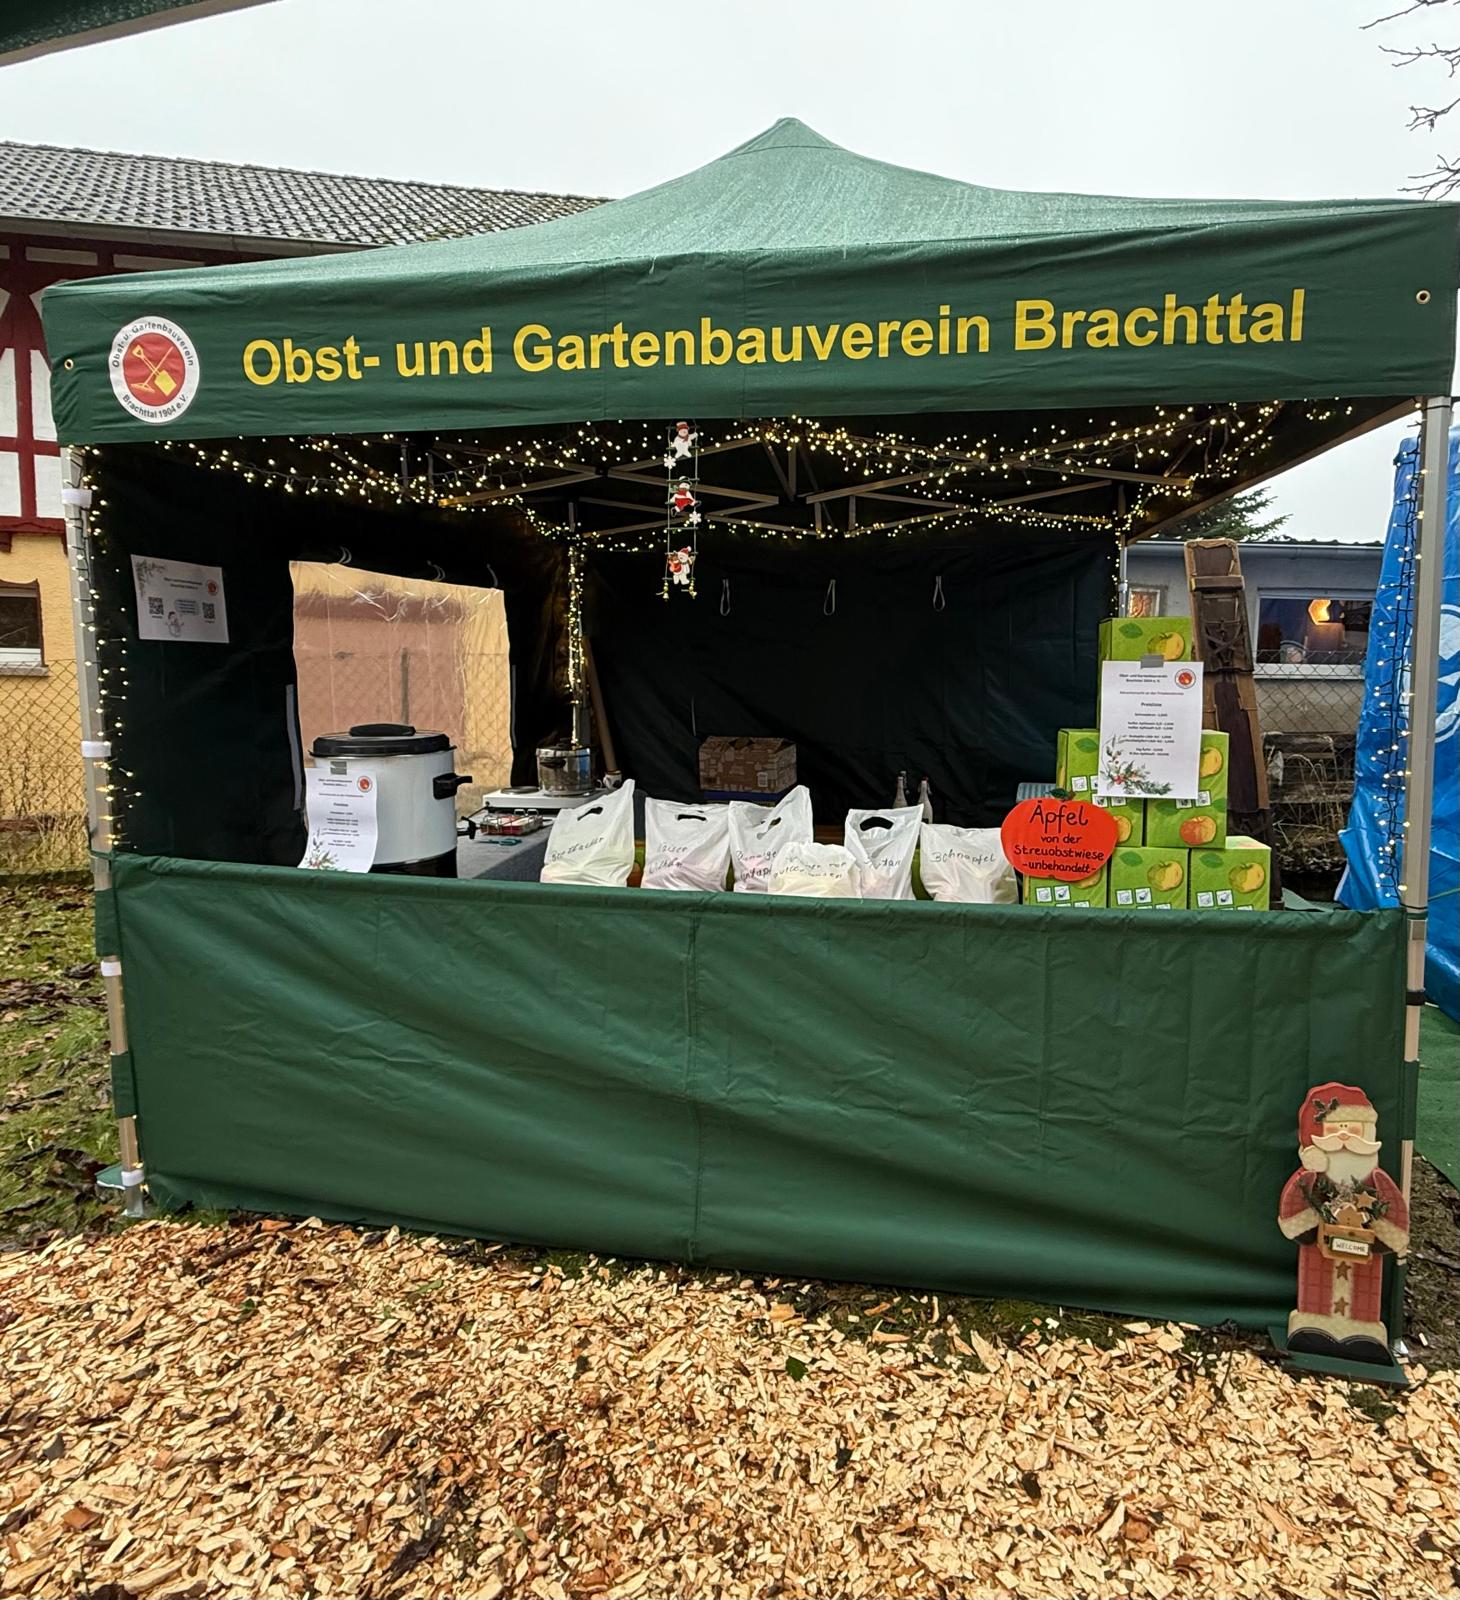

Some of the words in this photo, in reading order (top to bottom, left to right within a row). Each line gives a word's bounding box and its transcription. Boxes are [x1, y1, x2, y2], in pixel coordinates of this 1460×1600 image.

[131, 321, 194, 366] Gartenbauverein
[243, 335, 380, 385] Obst-
[396, 326, 492, 377] und
[513, 304, 990, 373] Gartenbauverein
[1014, 288, 1305, 351] Brachttal
[122, 394, 157, 418] Brachttal
[159, 405, 177, 418] 1904
[1029, 800, 1088, 833] Äpfel
[1041, 835, 1059, 843] von
[1063, 833, 1082, 843] der
[1014, 845, 1104, 861] Streuobstwiese
[1335, 1241, 1366, 1252] WELCOME
